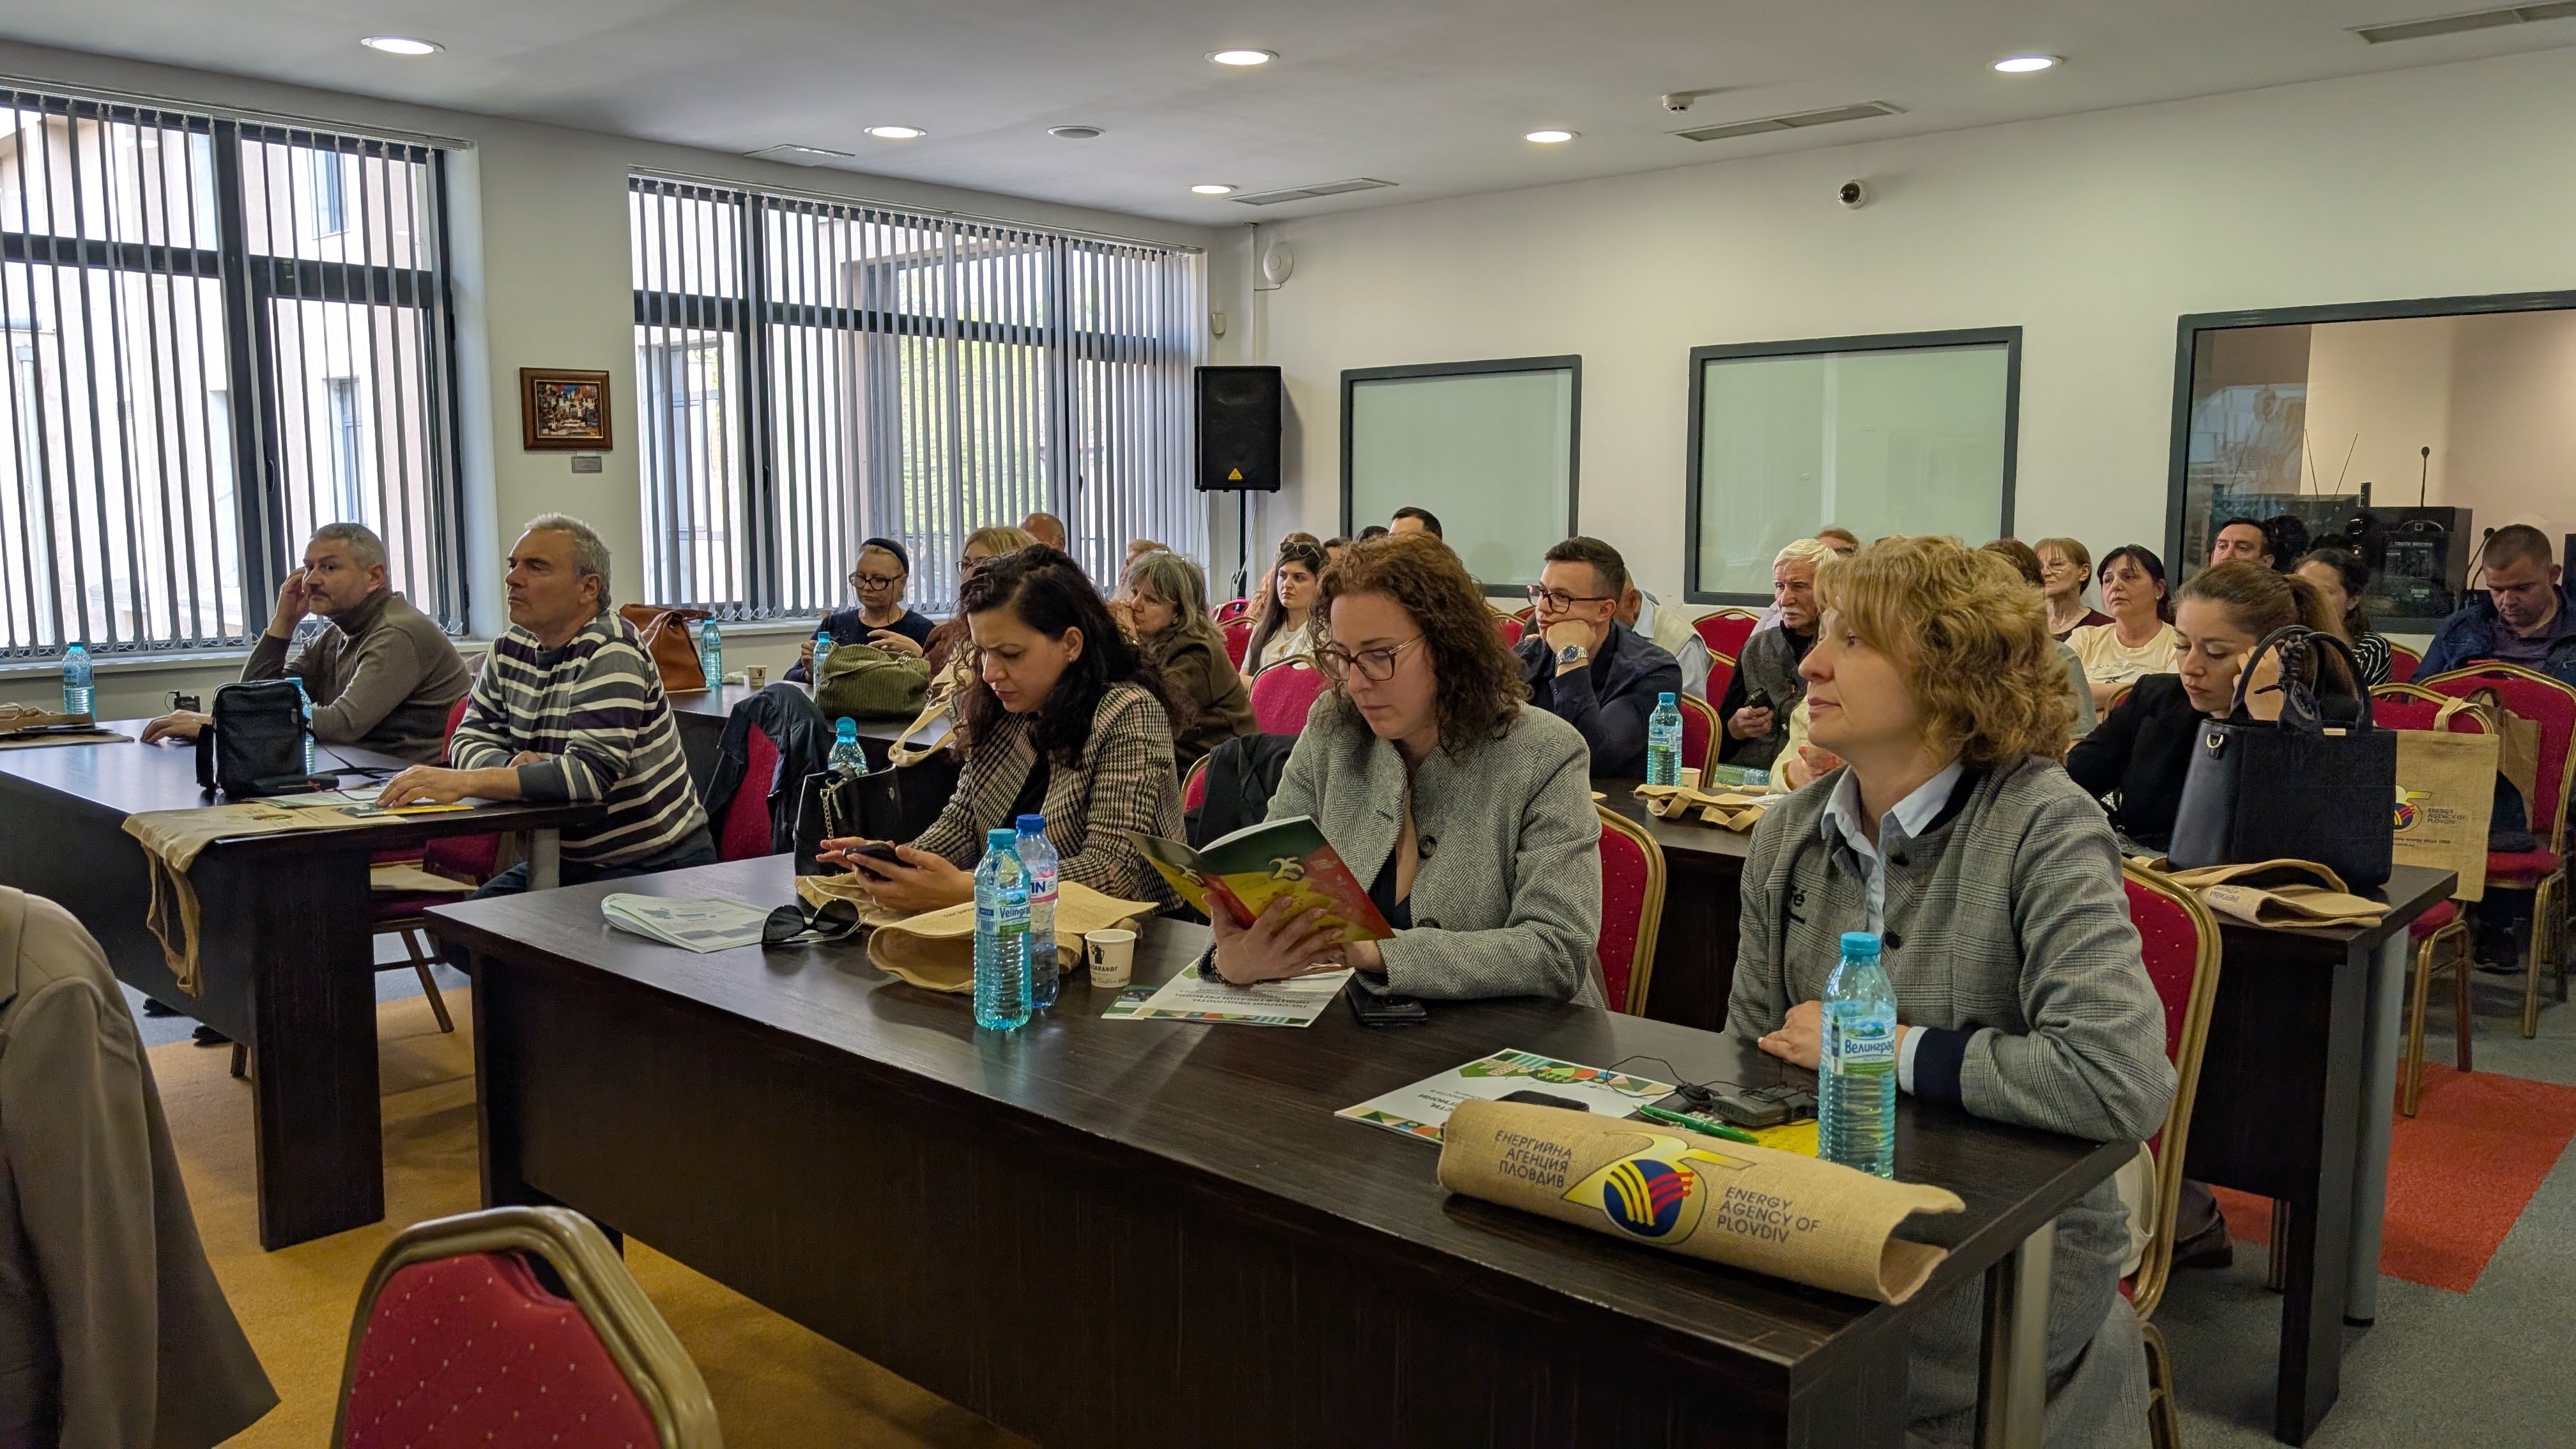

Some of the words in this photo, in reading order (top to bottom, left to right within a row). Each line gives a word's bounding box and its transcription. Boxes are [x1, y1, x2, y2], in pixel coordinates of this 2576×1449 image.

[999, 907, 1031, 919] Velingra
[1494, 1130, 1572, 1160] ЕНЕРГИЙНА
[1498, 1160, 1564, 1188] ПЛОВДИВ
[1506, 1147, 1568, 1173] АГЕНЦИЯ
[1725, 1186, 1793, 1209] ENERGY
[1717, 1215, 1790, 1243] PLOVDIV
[1719, 1200, 1793, 1226] AGENCY
[1796, 1216, 1820, 1232] OF
